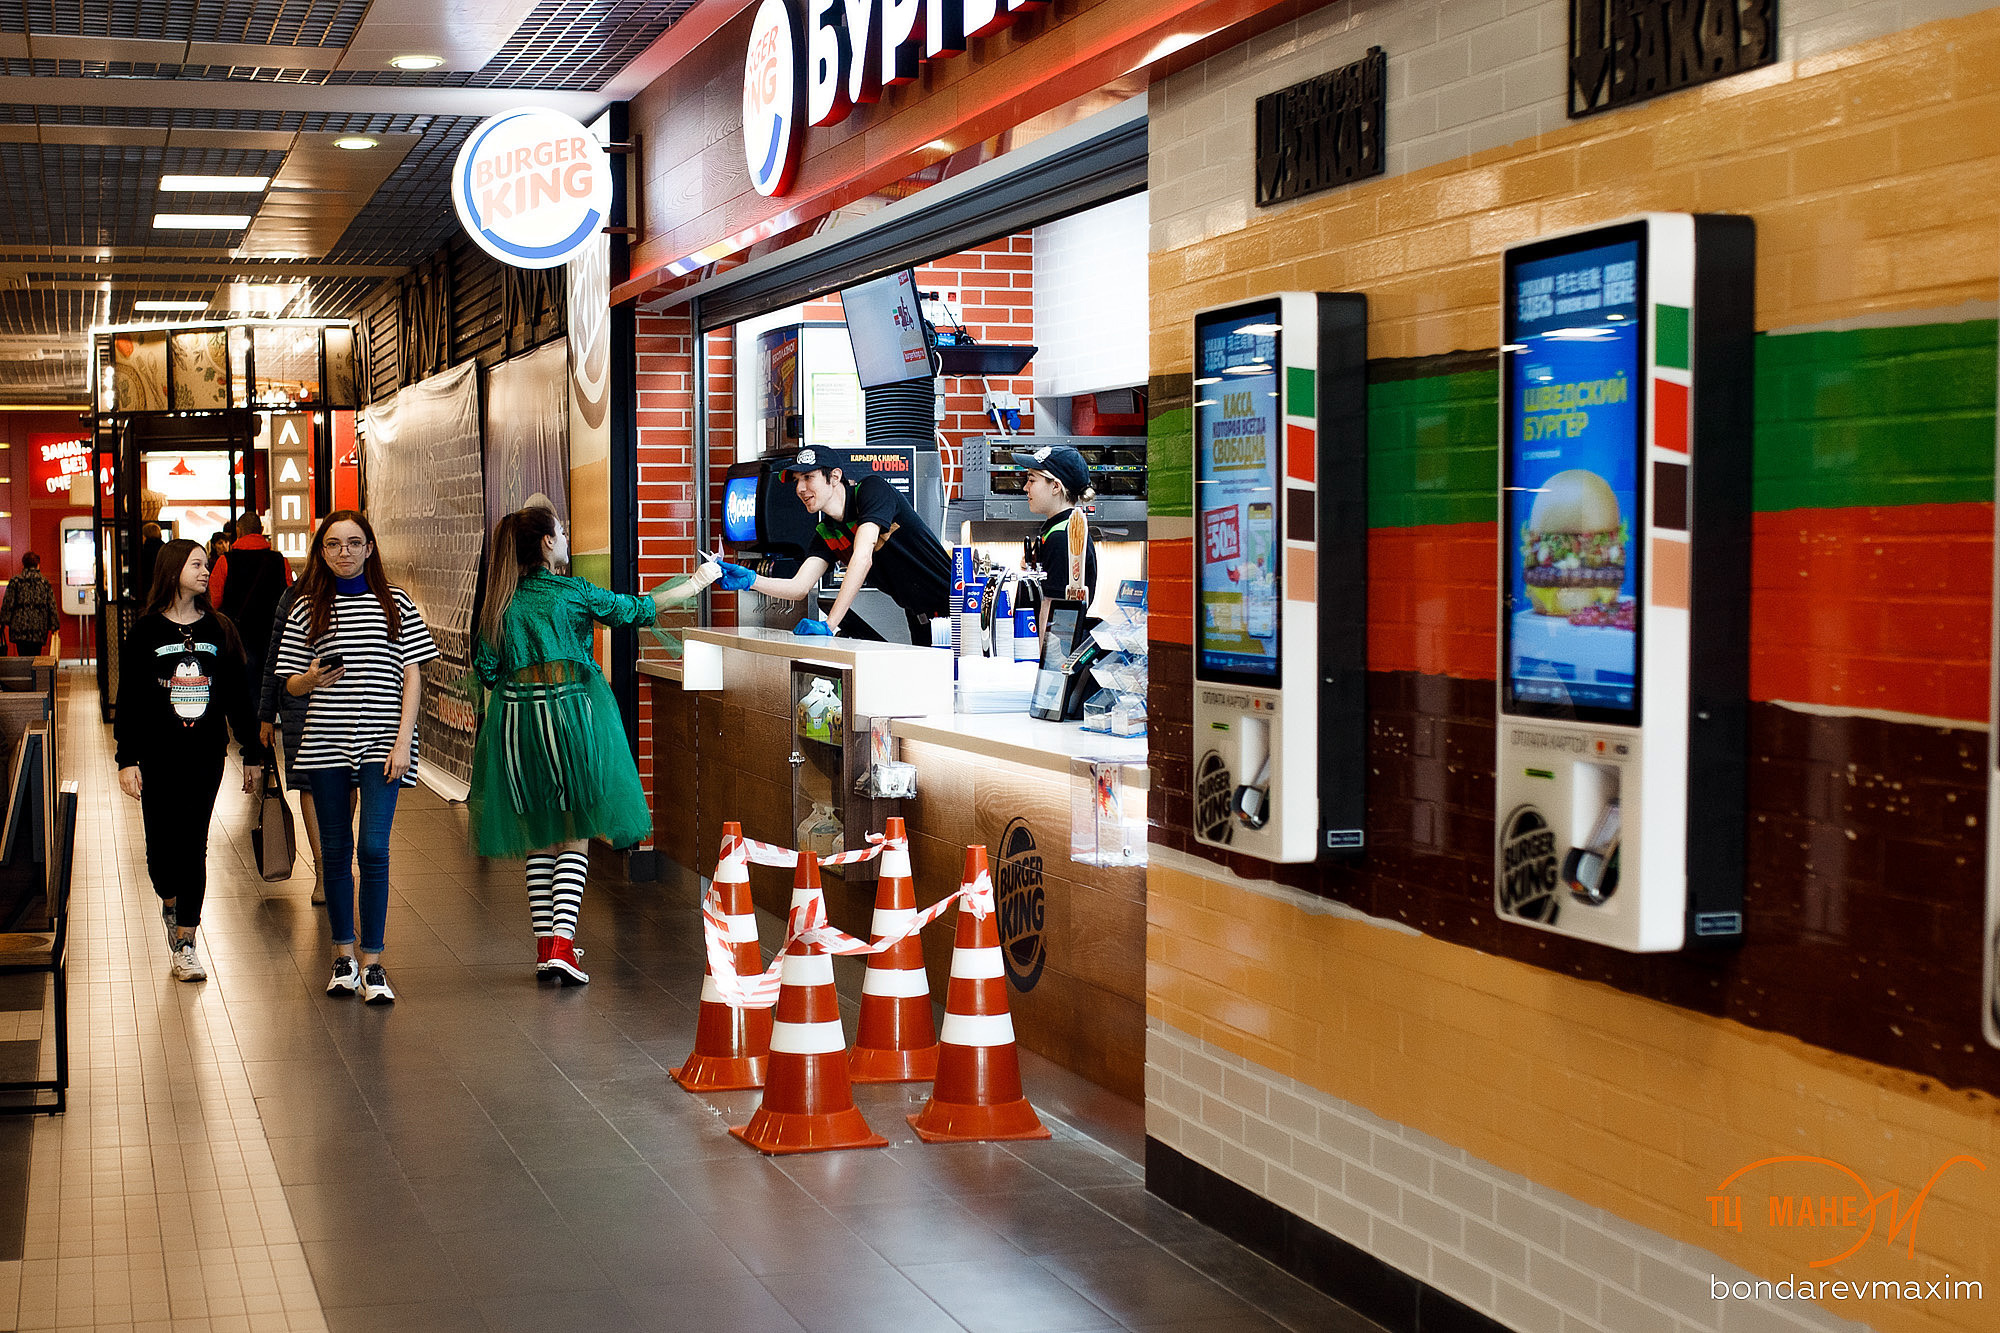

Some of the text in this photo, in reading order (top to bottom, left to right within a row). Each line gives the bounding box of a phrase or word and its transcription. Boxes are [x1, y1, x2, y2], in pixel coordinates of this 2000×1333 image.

[476, 137, 588, 189] BURGER
[1282, 103, 1379, 196] ЗАКАЗ
[482, 162, 593, 228] KING
[1523, 370, 1628, 413] ШВЕДСКИЙ
[1523, 411, 1589, 441] БУРГЕР
[850, 454, 878, 462] КАРЬЕРА
[872, 460, 909, 472] ОГОНЬ!
[1213, 435, 1266, 465] СВОБОДНА
[278, 419, 307, 581] ЛАПШ
[954, 551, 963, 577] pepsi
[1198, 771, 1231, 805] BURGER
[1200, 788, 1232, 829] KING
[1504, 831, 1556, 873] BURGER
[1000, 855, 1044, 899] BURGER
[1506, 855, 1558, 907] KING
[1001, 887, 1045, 944] KING
